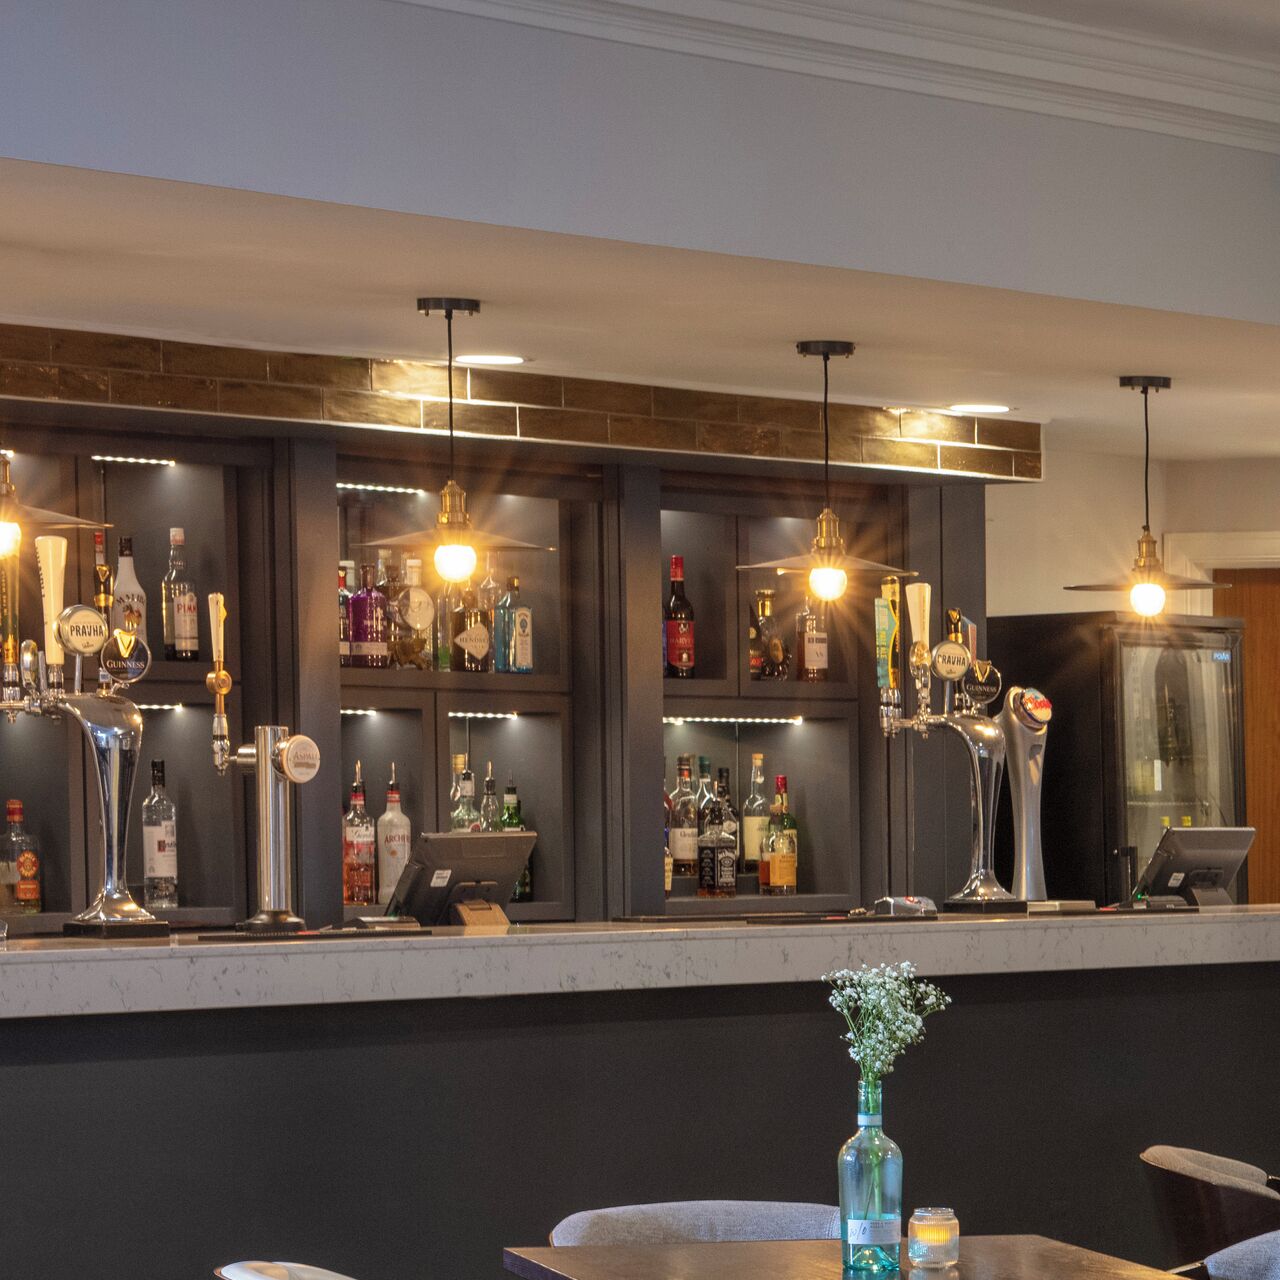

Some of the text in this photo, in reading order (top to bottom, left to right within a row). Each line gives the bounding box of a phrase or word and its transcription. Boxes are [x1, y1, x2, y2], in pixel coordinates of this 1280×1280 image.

[70, 624, 104, 637] PRAVHA
[106, 660, 145, 669] GUINNESS
[966, 684, 997, 693] GUINNESS
